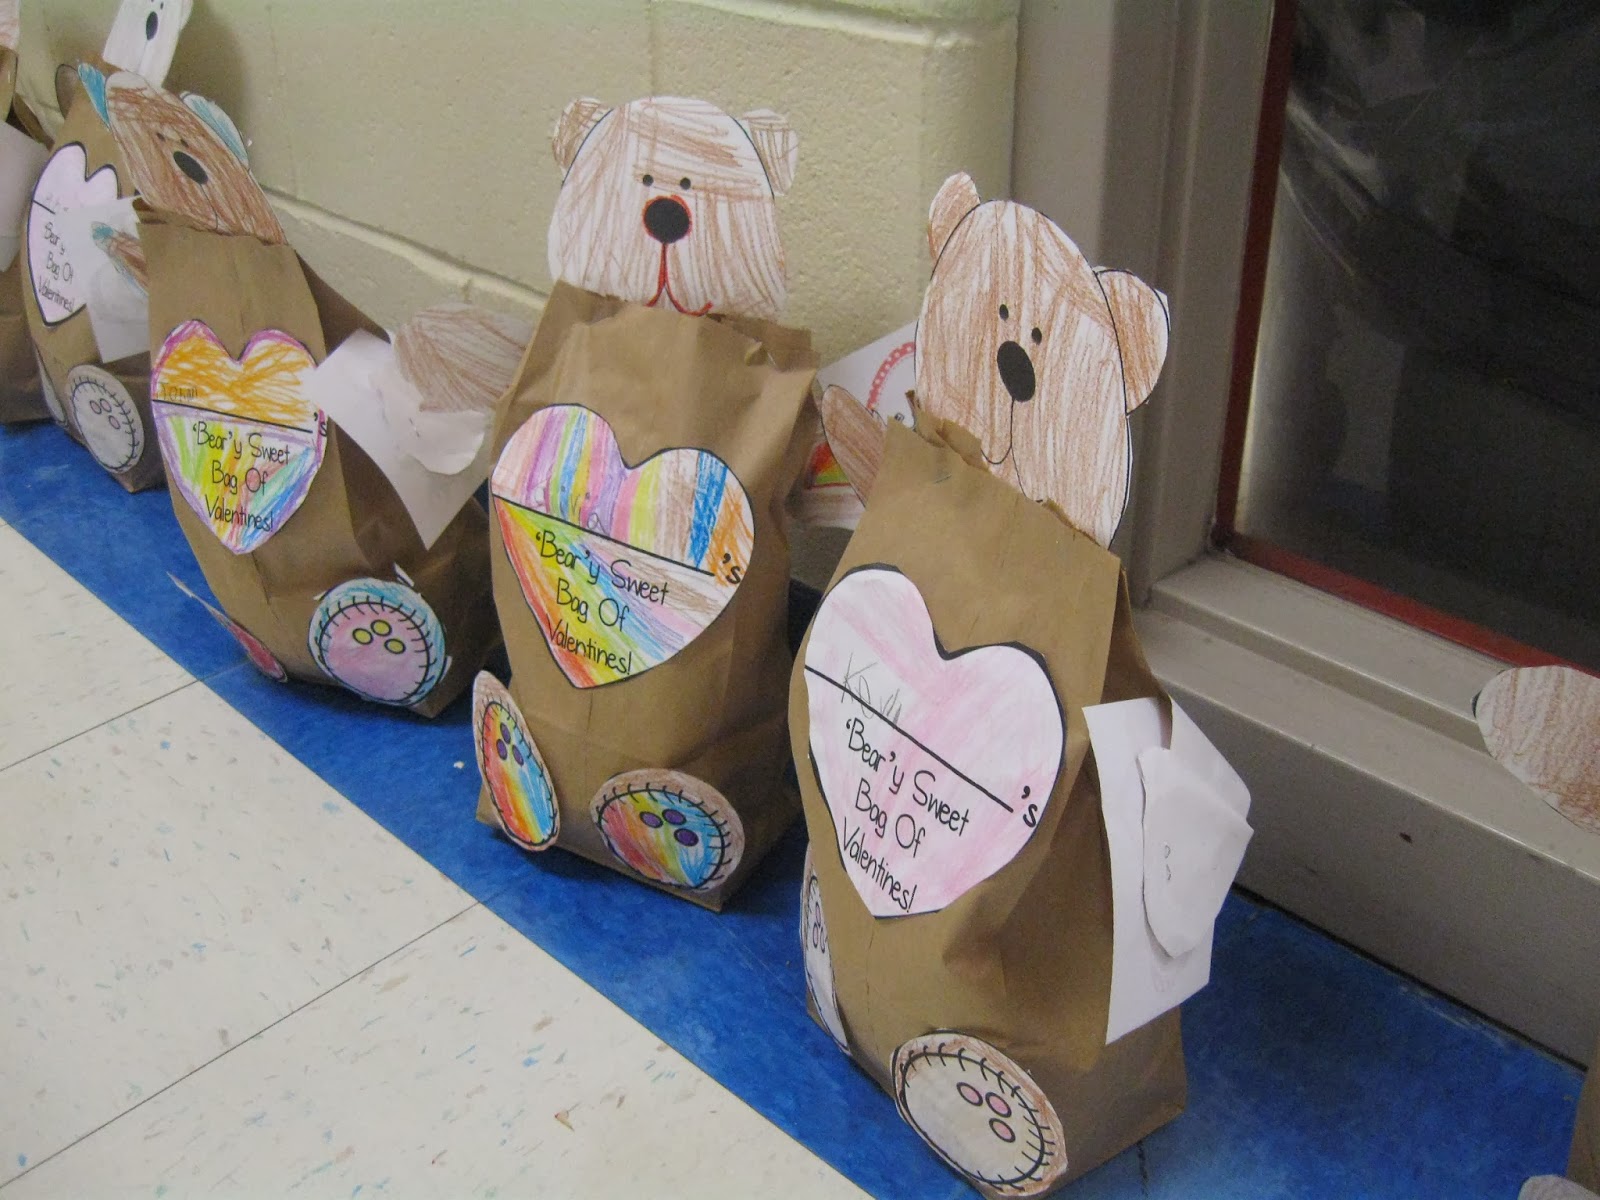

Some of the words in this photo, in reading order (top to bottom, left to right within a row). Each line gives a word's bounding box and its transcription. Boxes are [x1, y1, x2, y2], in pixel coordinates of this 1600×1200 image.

[248, 433, 291, 464] Sweet
[212, 460, 238, 495] Bag
[245, 468, 269, 496] Of
[205, 495, 274, 533] Valentines!
[556, 578, 589, 624] Bag
[598, 598, 630, 633] Of
[610, 559, 670, 606] Sweet
[546, 613, 633, 676] Valentines!
[855, 777, 887, 839] Bag
[895, 813, 926, 859] Of
[912, 770, 970, 837] Sweet
[842, 816, 918, 914] Valentines!
